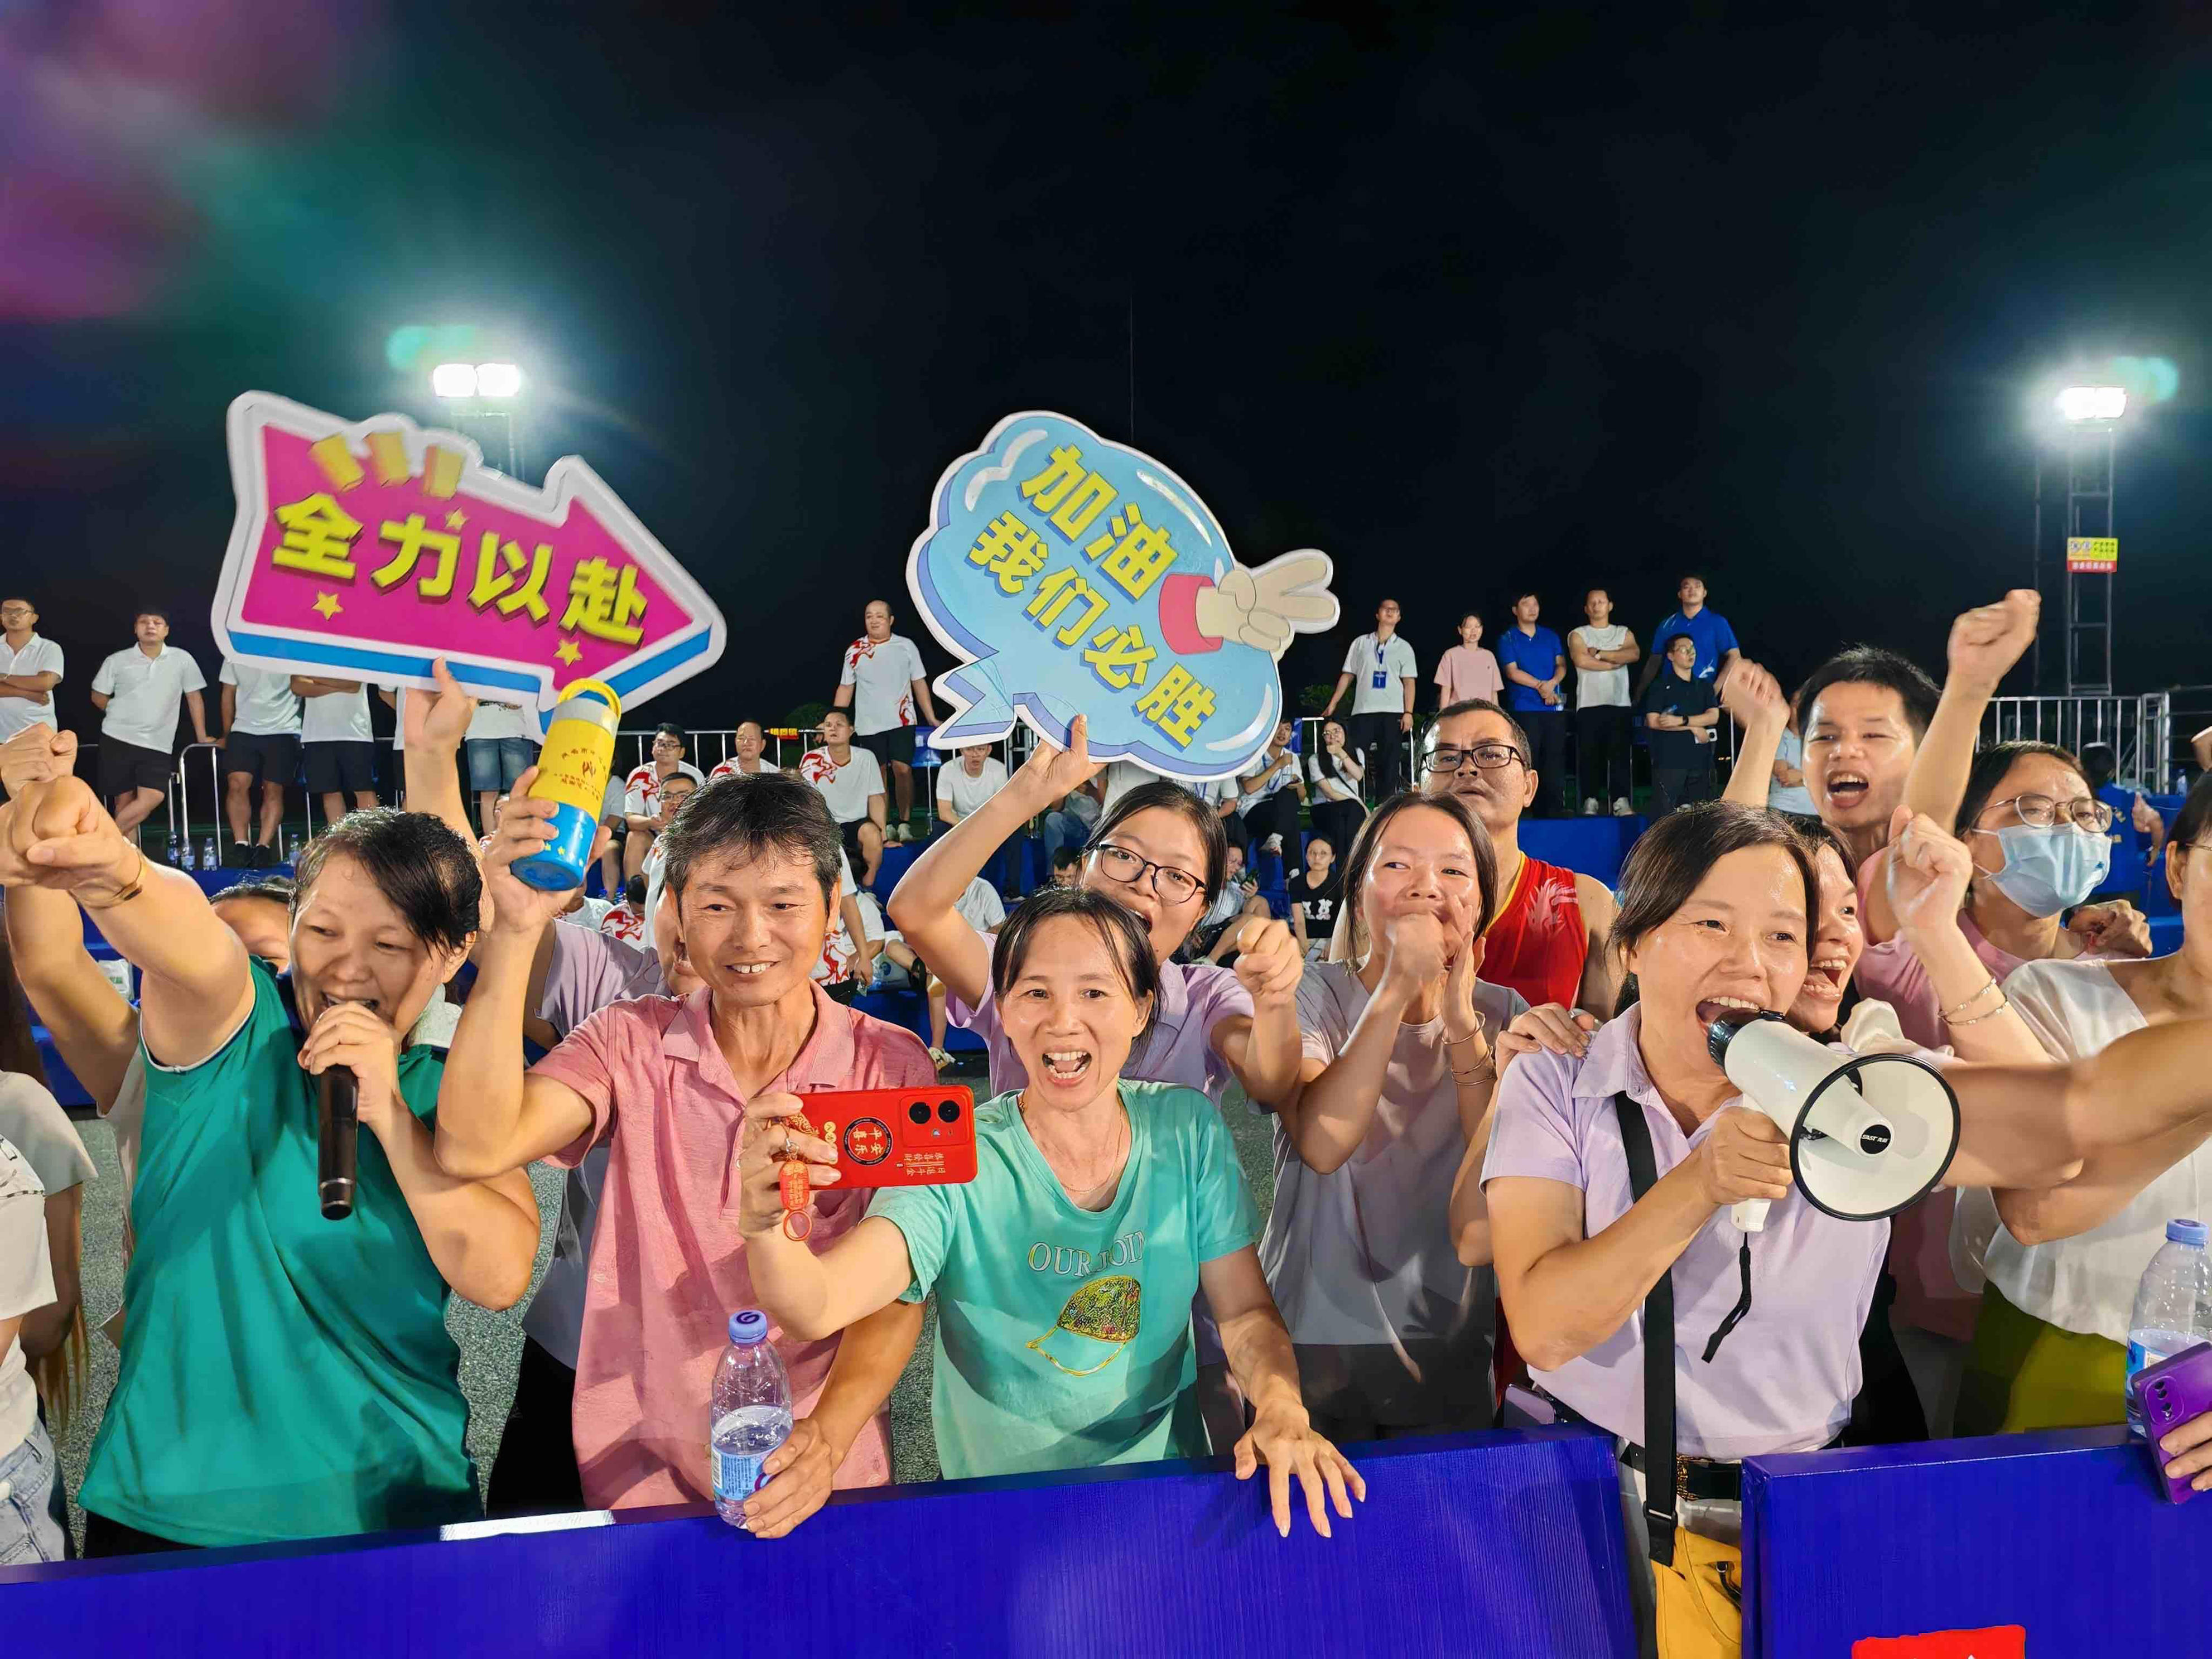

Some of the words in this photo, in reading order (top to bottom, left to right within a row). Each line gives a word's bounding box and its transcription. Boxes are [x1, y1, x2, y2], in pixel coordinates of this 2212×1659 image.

[1017, 444, 1179, 602] 加油
[272, 494, 649, 649] 全力以赴
[965, 510, 1217, 750] 我们必胜
[853, 1127, 868, 1155] 喜乐
[869, 1127, 884, 1155] 平安
[1028, 1242, 1091, 1277] OUR
